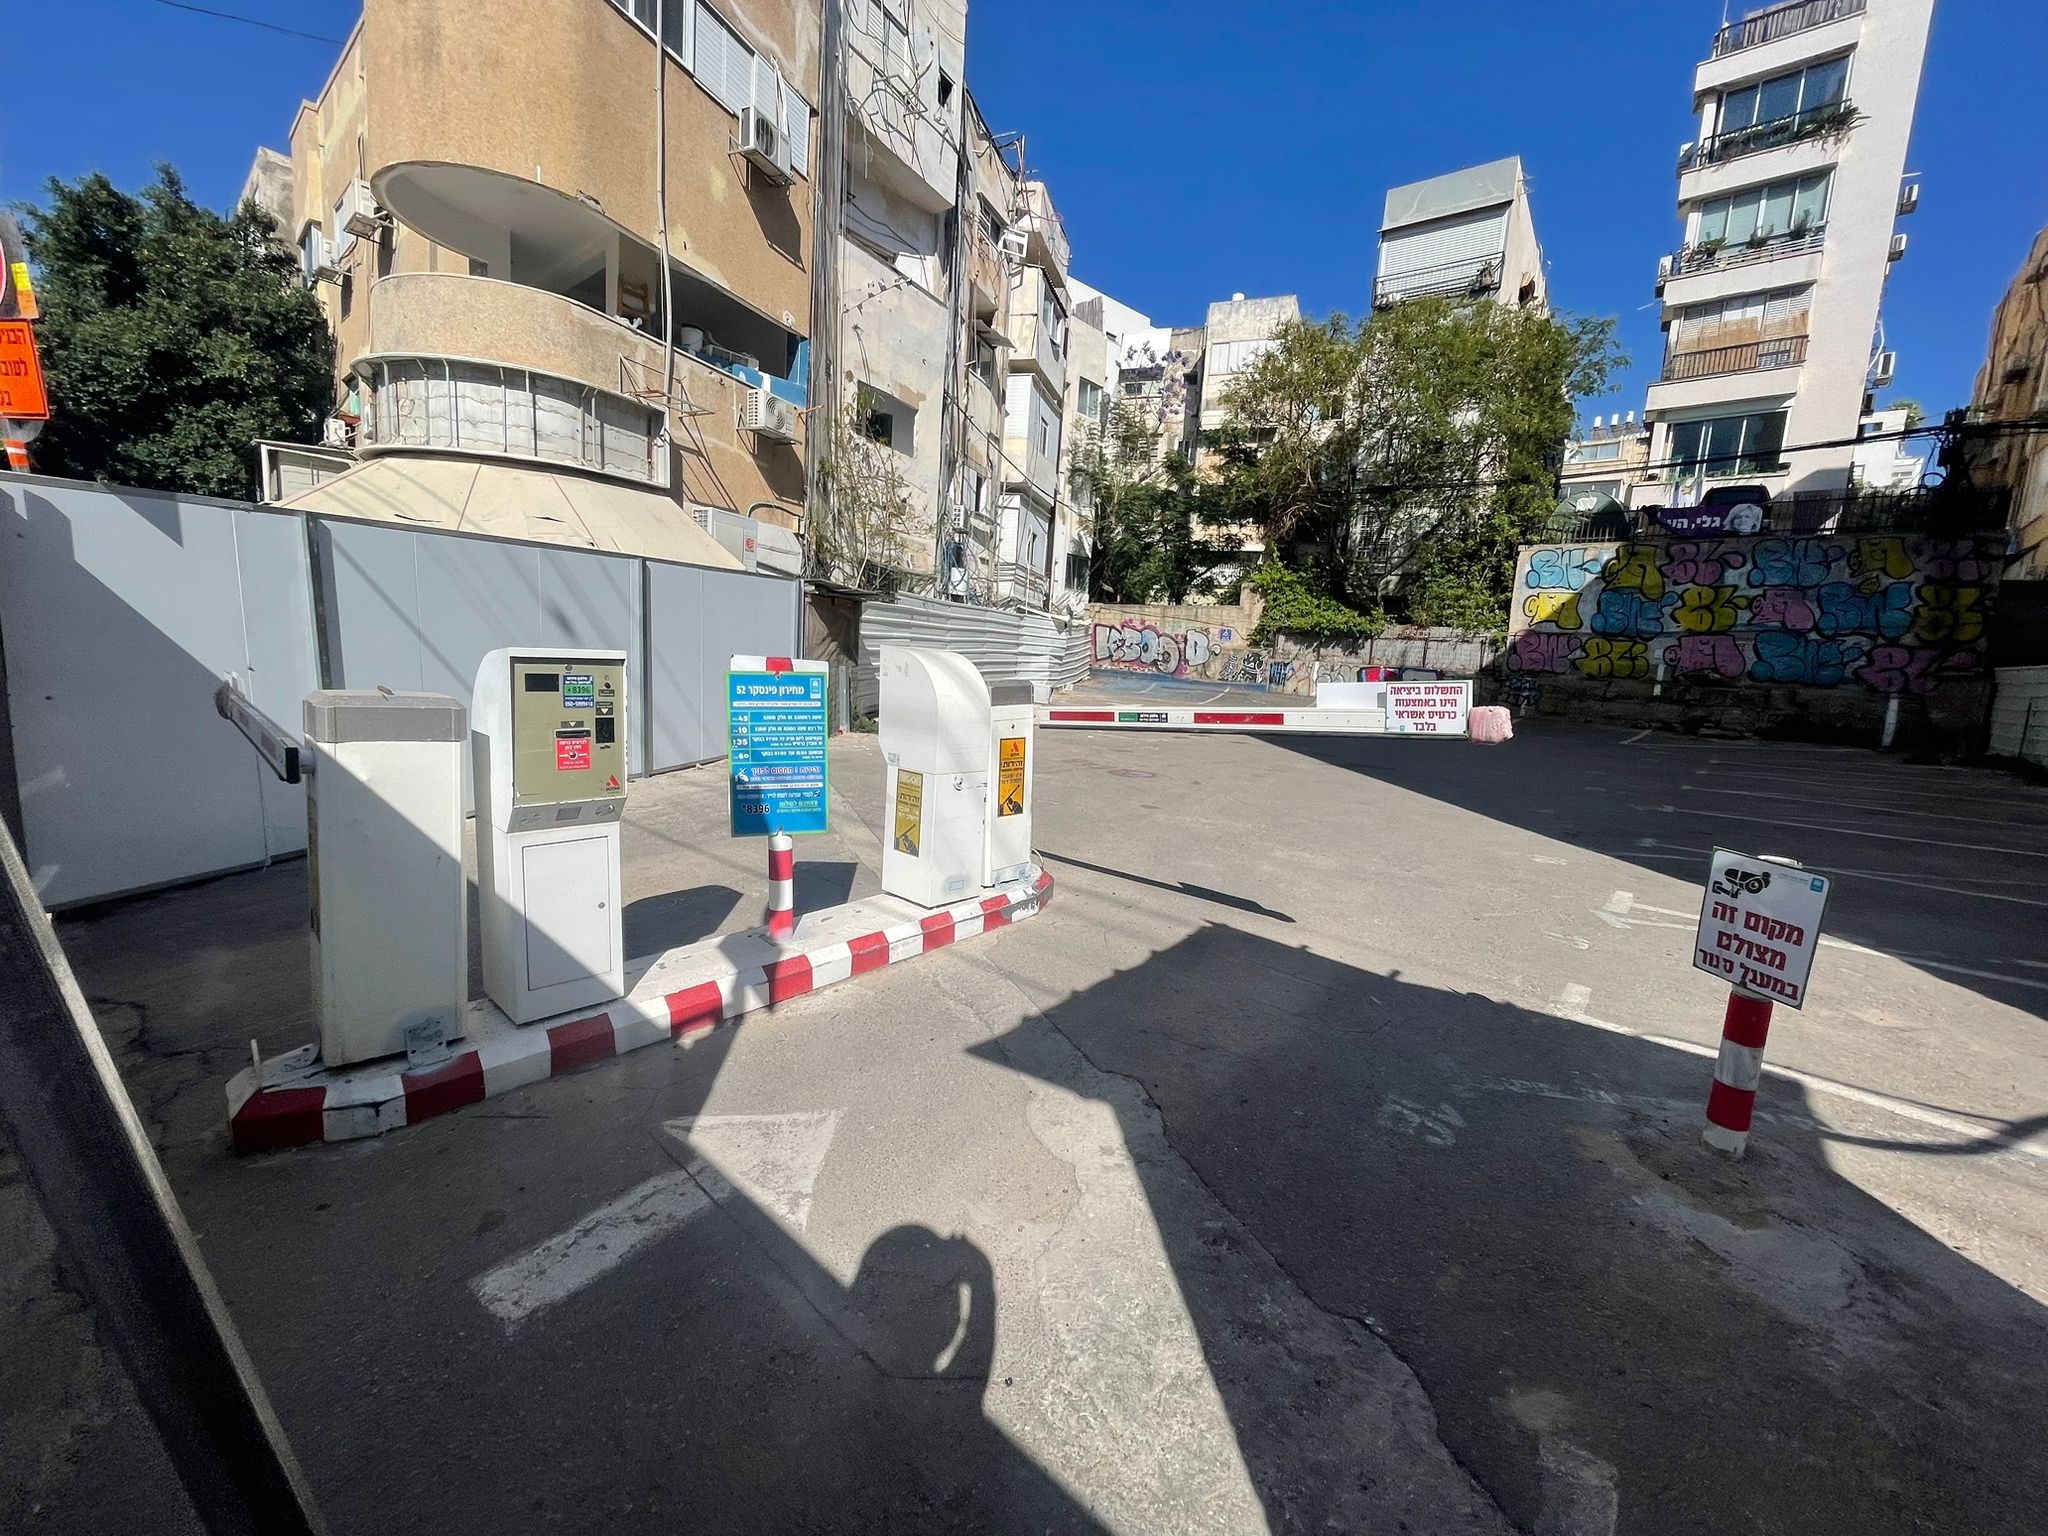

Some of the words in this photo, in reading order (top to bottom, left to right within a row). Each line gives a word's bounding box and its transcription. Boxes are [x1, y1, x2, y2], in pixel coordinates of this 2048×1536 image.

[1691, 515, 1721, 530] גלי,
[736, 685, 747, 695] 52
[747, 685, 778, 697] פינסקר
[779, 686, 805, 697] מחירון
[1390, 686, 1421, 695] ביציאה
[1424, 685, 1463, 695] התשלום
[1395, 698, 1437, 707] באמצעות
[1439, 698, 1457, 707] הינו
[1395, 710, 1425, 719] אשראי
[1428, 710, 1457, 719] כרטיס
[1413, 721, 1437, 731] בלבד
[1002, 760, 1023, 768] זהירות
[751, 766, 770, 776] לפניך
[771, 766, 795, 774] מחסום
[1712, 901, 1738, 924] זה
[1744, 911, 1804, 947] מקום
[1716, 930, 1787, 971] מצולם
[1699, 948, 1735, 974] סגור
[1739, 962, 1799, 1001] במעגל
